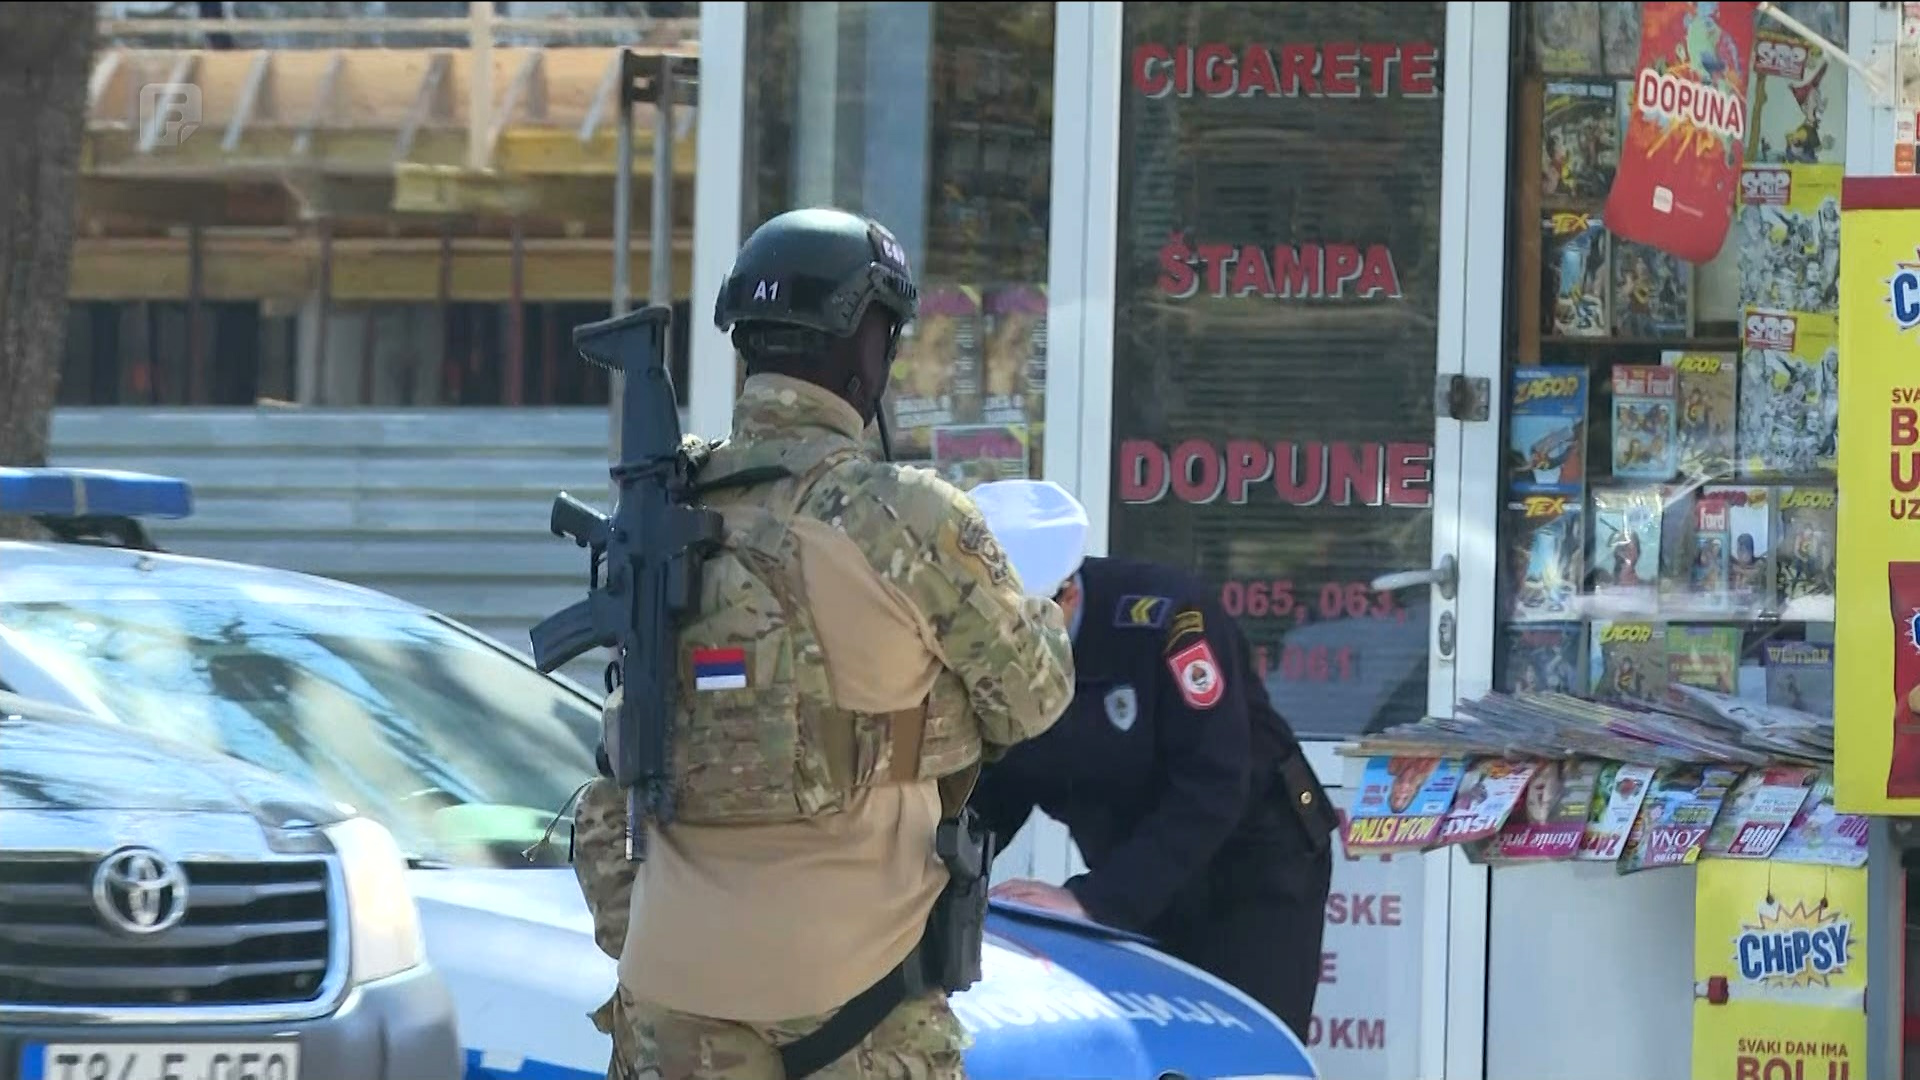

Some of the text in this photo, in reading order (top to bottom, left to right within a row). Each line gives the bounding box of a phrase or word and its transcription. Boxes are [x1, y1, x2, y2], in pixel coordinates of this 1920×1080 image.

[1132, 43, 1438, 98] CIGARETE
[1641, 70, 1744, 136] DOPUNA
[1552, 213, 1589, 234] TEX
[1160, 230, 1402, 298] ŠTAMPA
[753, 279, 779, 301] A1
[1119, 440, 1433, 507] DOPUNE
[1524, 496, 1566, 518] TEX
[1221, 580, 1307, 624] 065,
[1738, 1038, 1848, 1058] SVAKI DAN IMA
